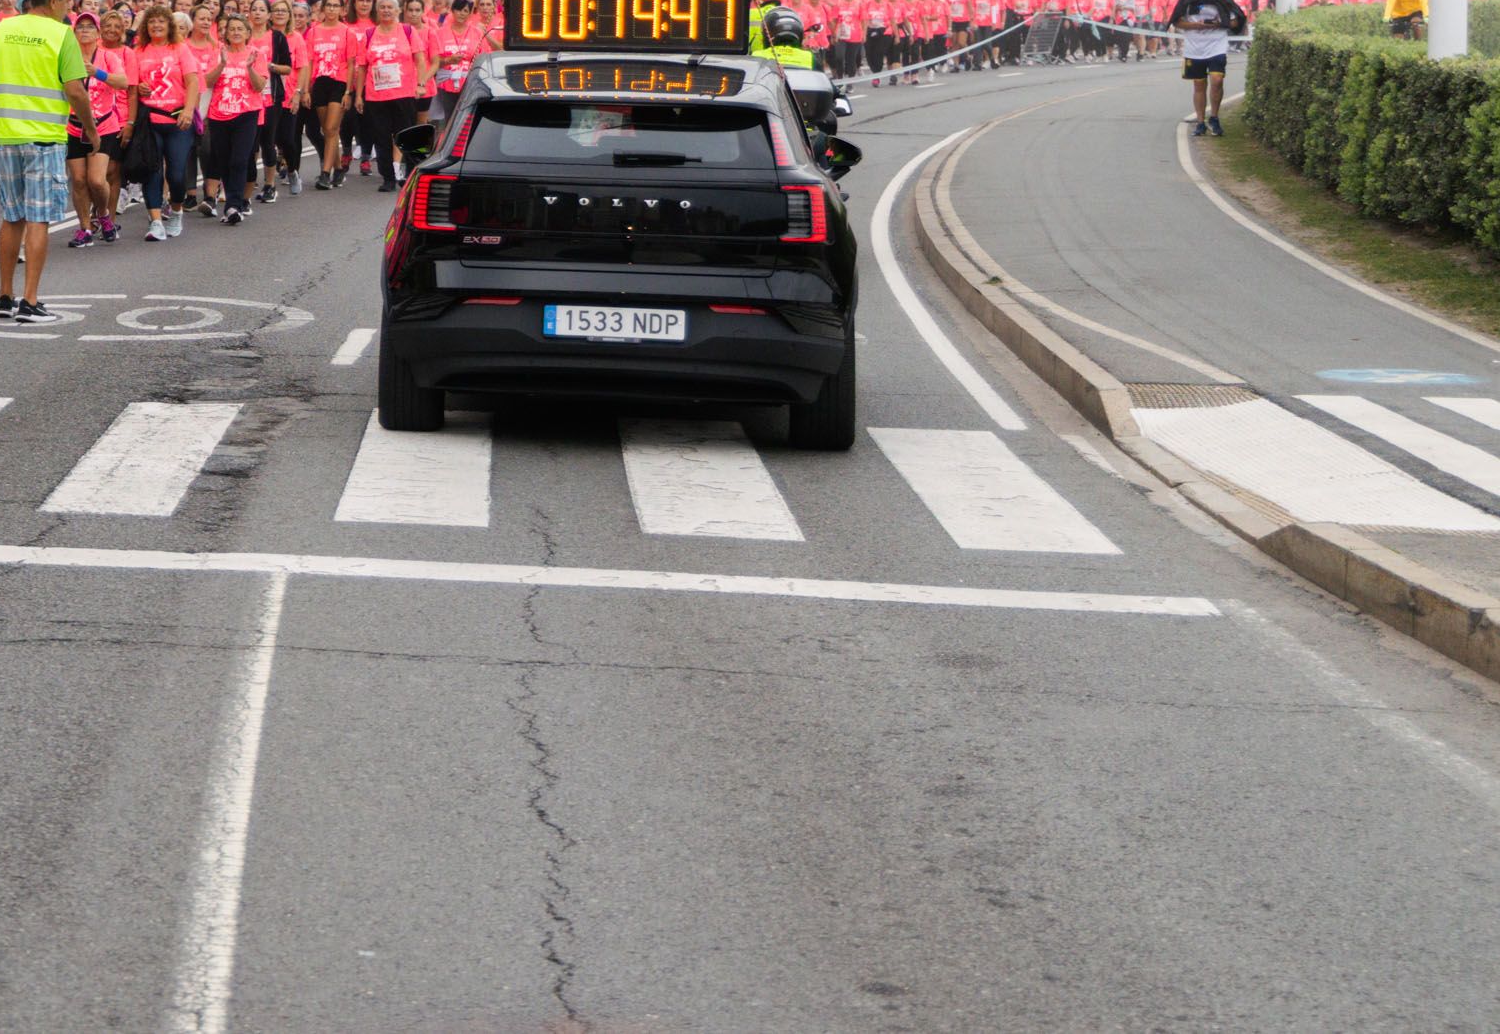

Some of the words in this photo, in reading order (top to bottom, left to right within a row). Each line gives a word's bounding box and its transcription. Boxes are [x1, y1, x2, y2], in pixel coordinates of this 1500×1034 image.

[543, 196, 692, 209] VOLVO
[566, 309, 623, 332] 1533
[632, 312, 678, 334] NDP
